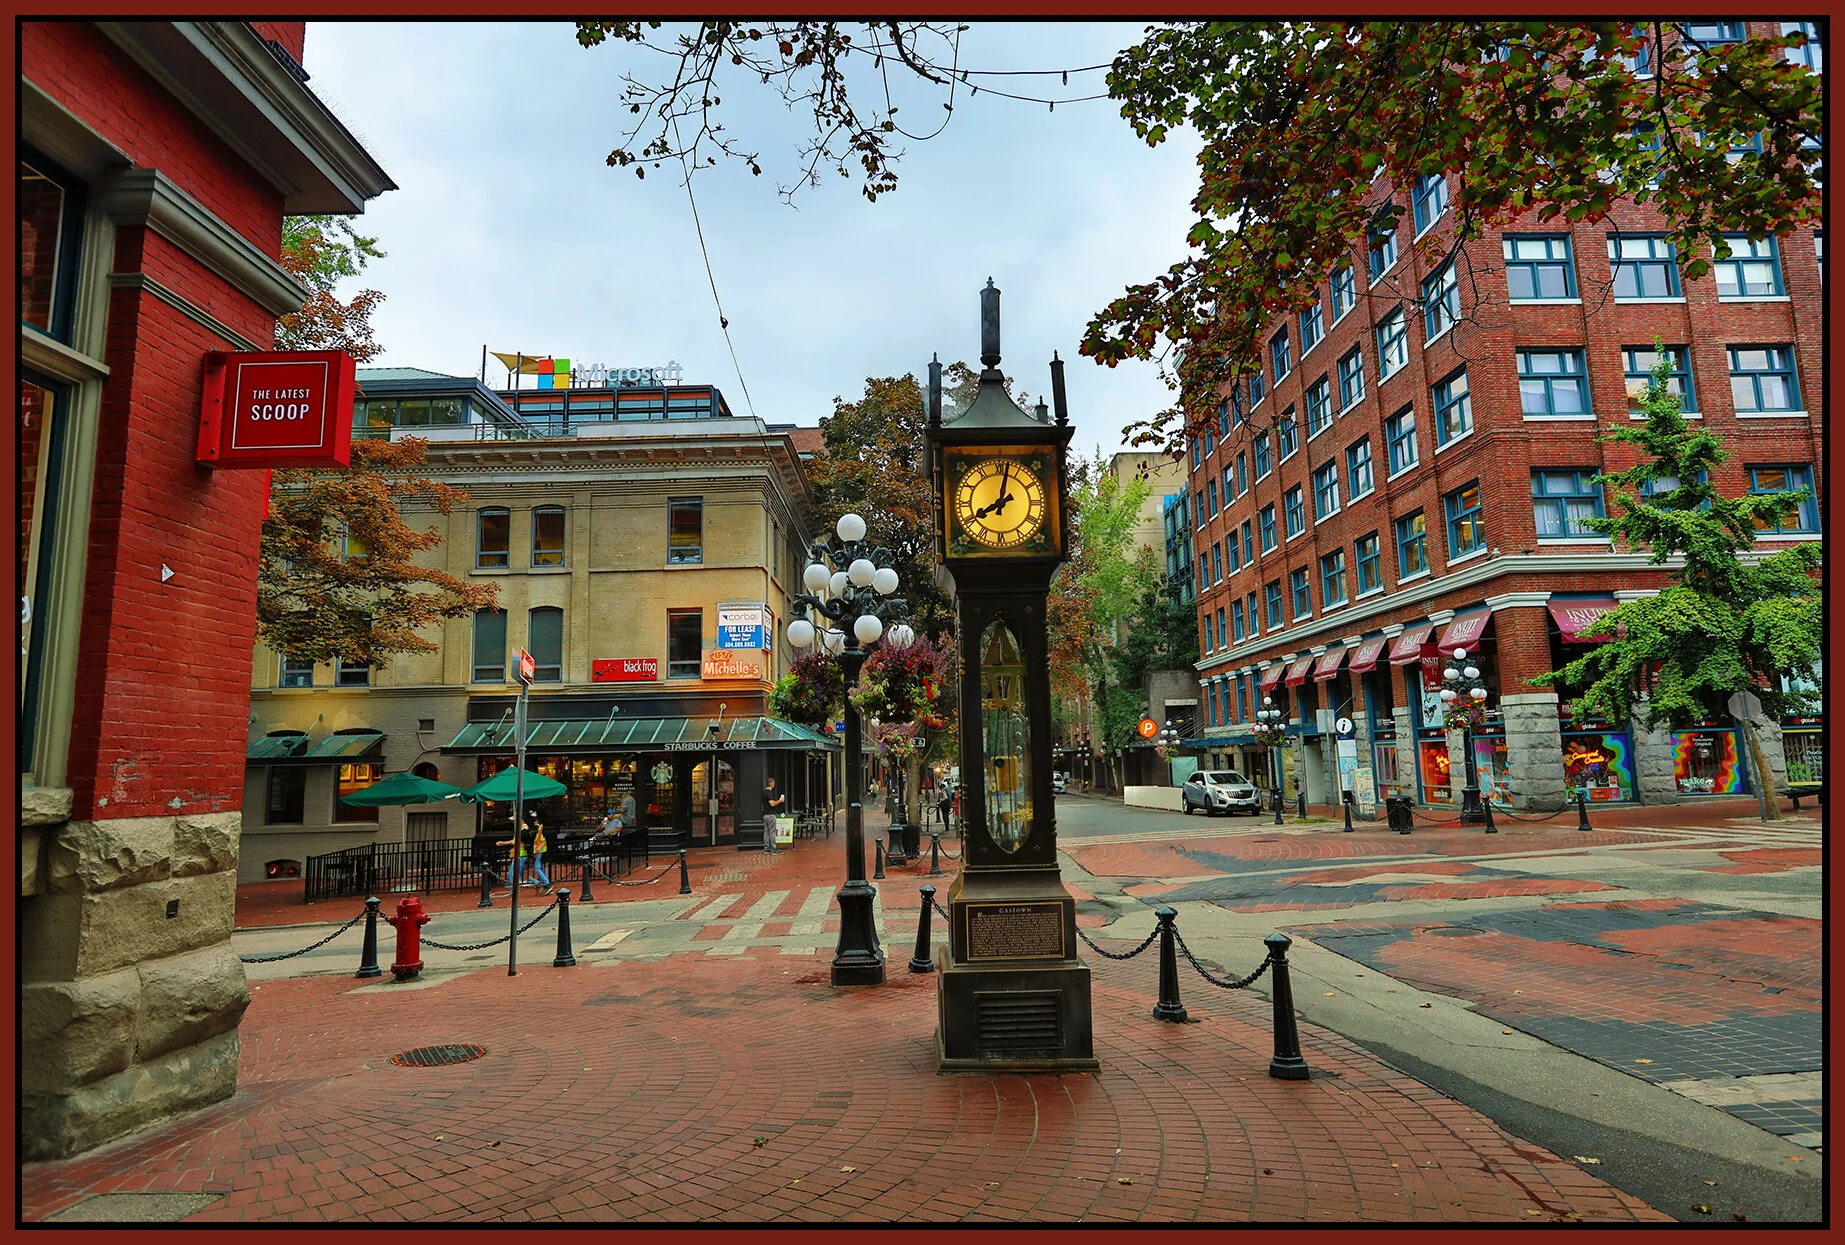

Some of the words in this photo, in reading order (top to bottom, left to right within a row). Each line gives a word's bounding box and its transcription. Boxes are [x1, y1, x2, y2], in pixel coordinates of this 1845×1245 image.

[577, 360, 683, 382] Microsoft
[253, 390, 270, 400] THE
[276, 388, 310, 399] LATEST
[251, 404, 310, 420] SCOOP
[728, 612, 758, 620] corbel
[624, 660, 641, 672] black
[642, 660, 656, 674] frog
[704, 661, 758, 675] Michelle's
[1144, 722, 1153, 734] P
[664, 742, 718, 751] STARBUCKS
[723, 741, 756, 750] COFFEE
[1679, 777, 1704, 785] make
